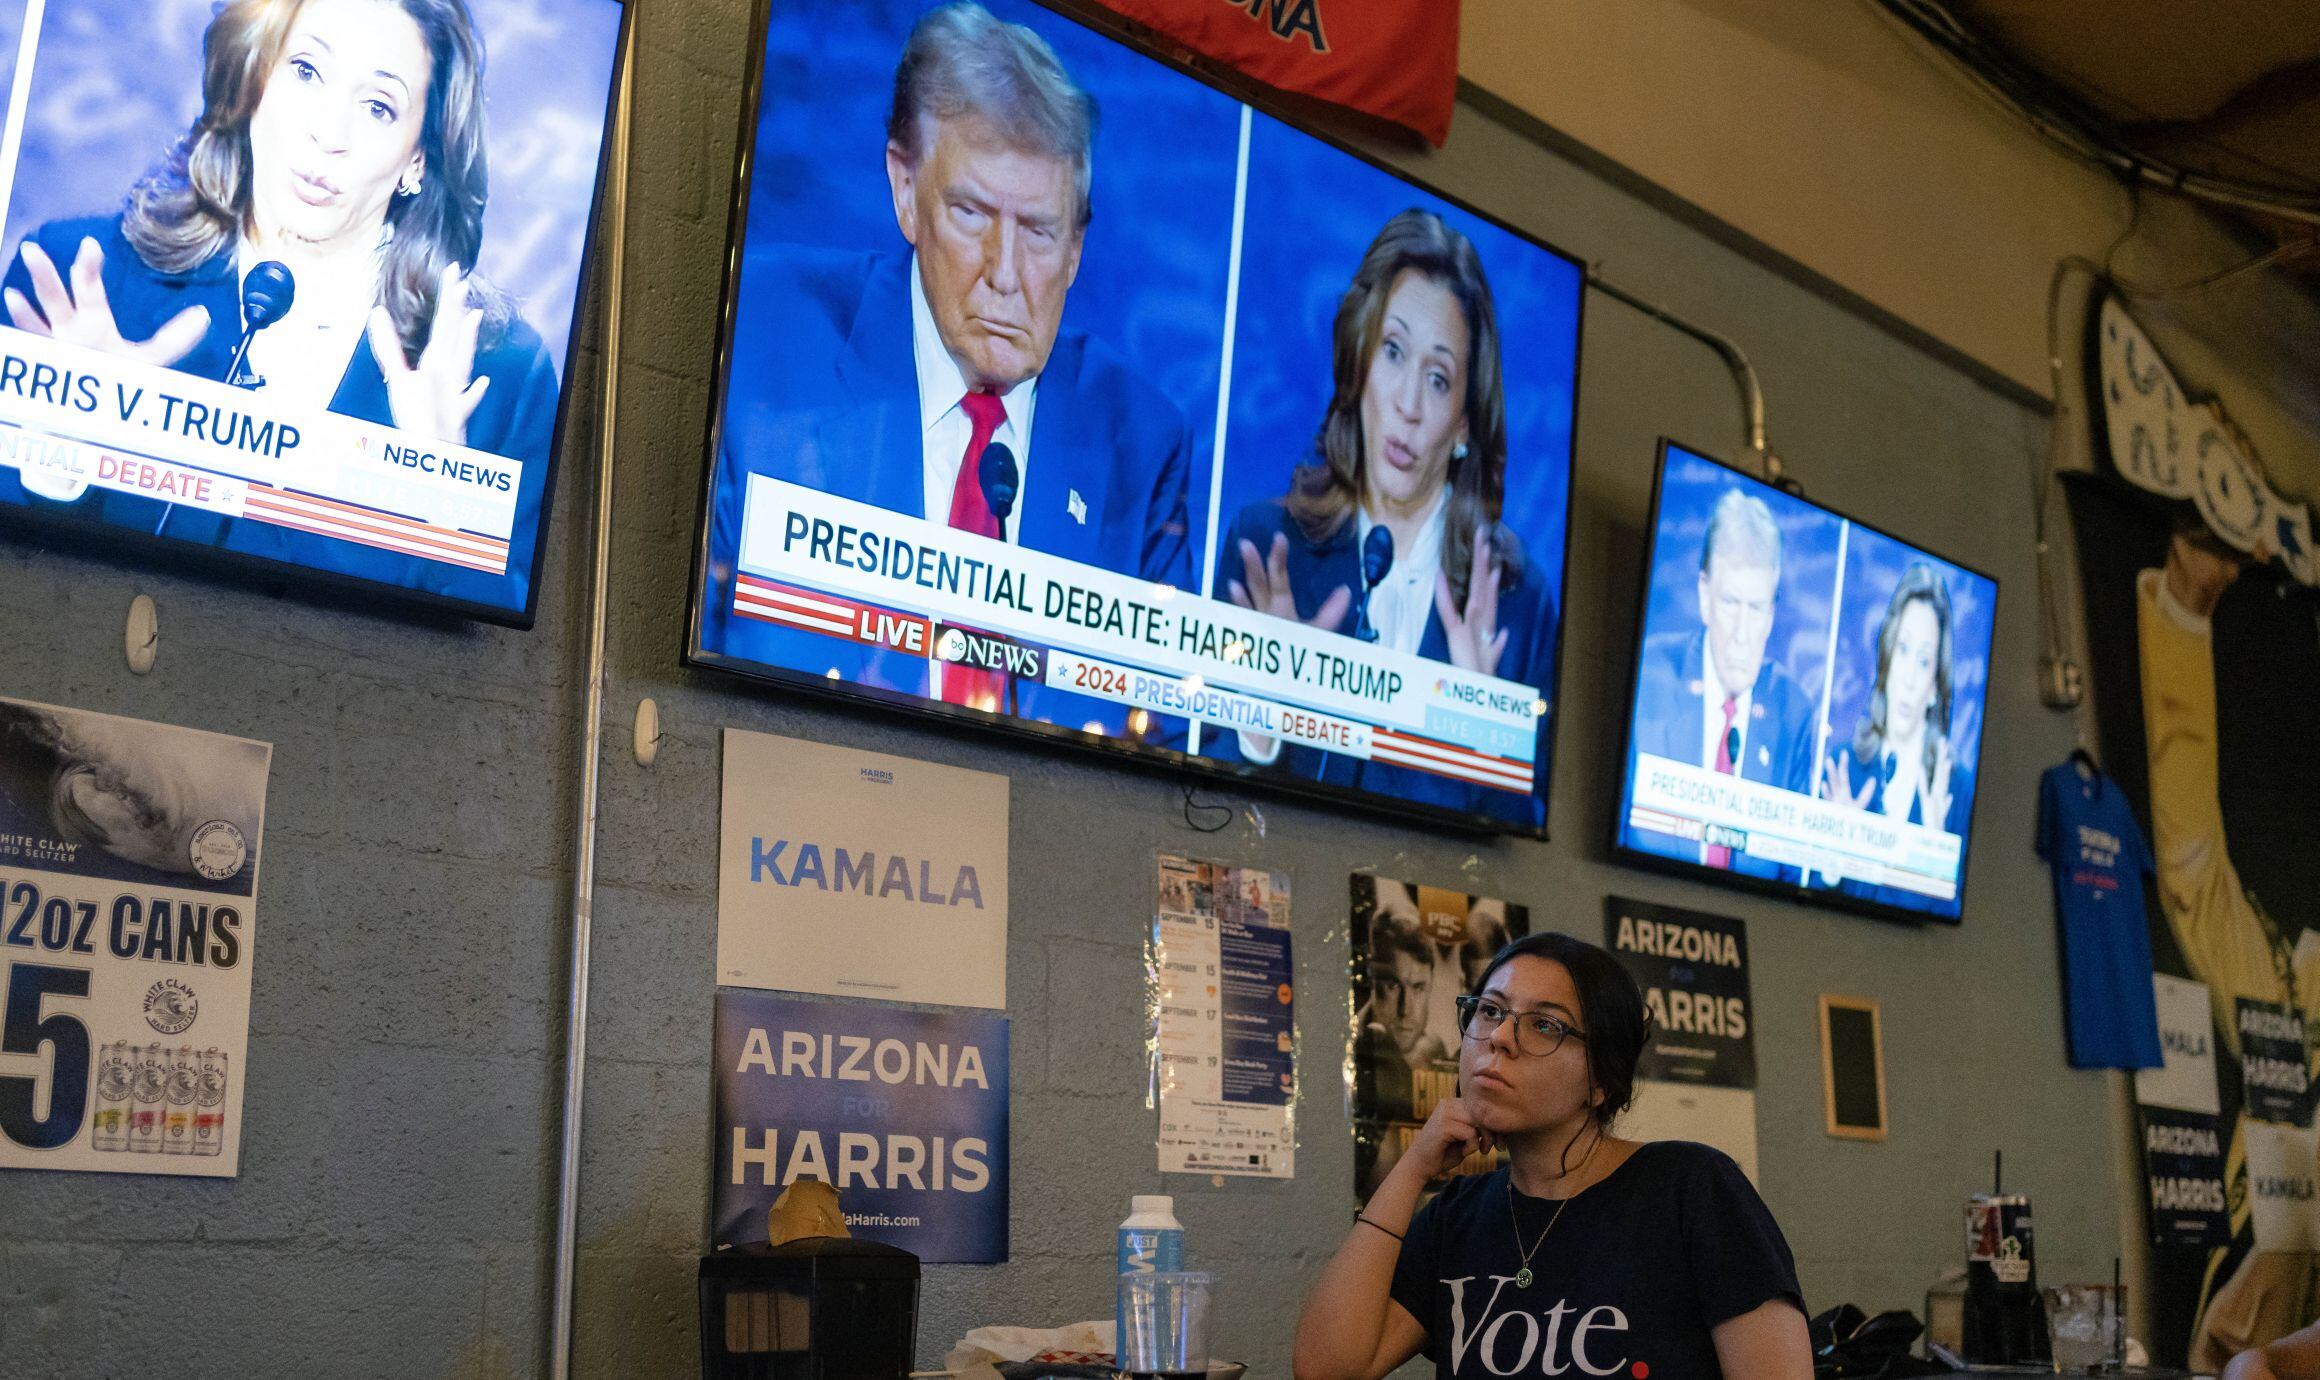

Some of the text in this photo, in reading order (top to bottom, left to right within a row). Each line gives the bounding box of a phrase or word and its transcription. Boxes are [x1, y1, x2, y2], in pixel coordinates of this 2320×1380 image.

[1224, 0, 1332, 54] NA
[0, 355, 101, 413] RRIS
[159, 393, 301, 459] TRUMP
[98, 455, 213, 502] DEBATE
[383, 443, 512, 491] NBC NEWS
[783, 510, 1034, 613] PRESIDENTIAL
[1044, 580, 1169, 647] DEBATE:
[1178, 615, 1281, 674] HARRIS
[1315, 652, 1404, 704] TRUMP
[860, 610, 924, 651] LIVE
[965, 634, 1039, 678] NEWS
[1075, 663, 1351, 748] 2024 PRESIDENTIAL DEBATE
[1452, 682, 1532, 718] NBC NEWS
[860, 768, 894, 780] HARRIS
[25, 848, 76, 863] SELTZER
[750, 836, 985, 910] KAMALA
[108, 893, 242, 970] CANS
[1616, 916, 1741, 969] ARIZONA
[143, 979, 196, 1013] WHITE CLAW
[1643, 987, 1747, 1040] ARRIS
[736, 1027, 989, 1090] ARIZONA
[2164, 1029, 2206, 1056] MALA
[2243, 1053, 2307, 1094] HARRIS
[842, 1096, 890, 1119] FOR
[731, 1126, 990, 1193] HARRIS
[2147, 1124, 2220, 1158] ARIZONA
[2151, 1175, 2225, 1213] HARRIS
[843, 1211, 920, 1227] aHarris.com
[1440, 1275, 1650, 1379] Vote.
